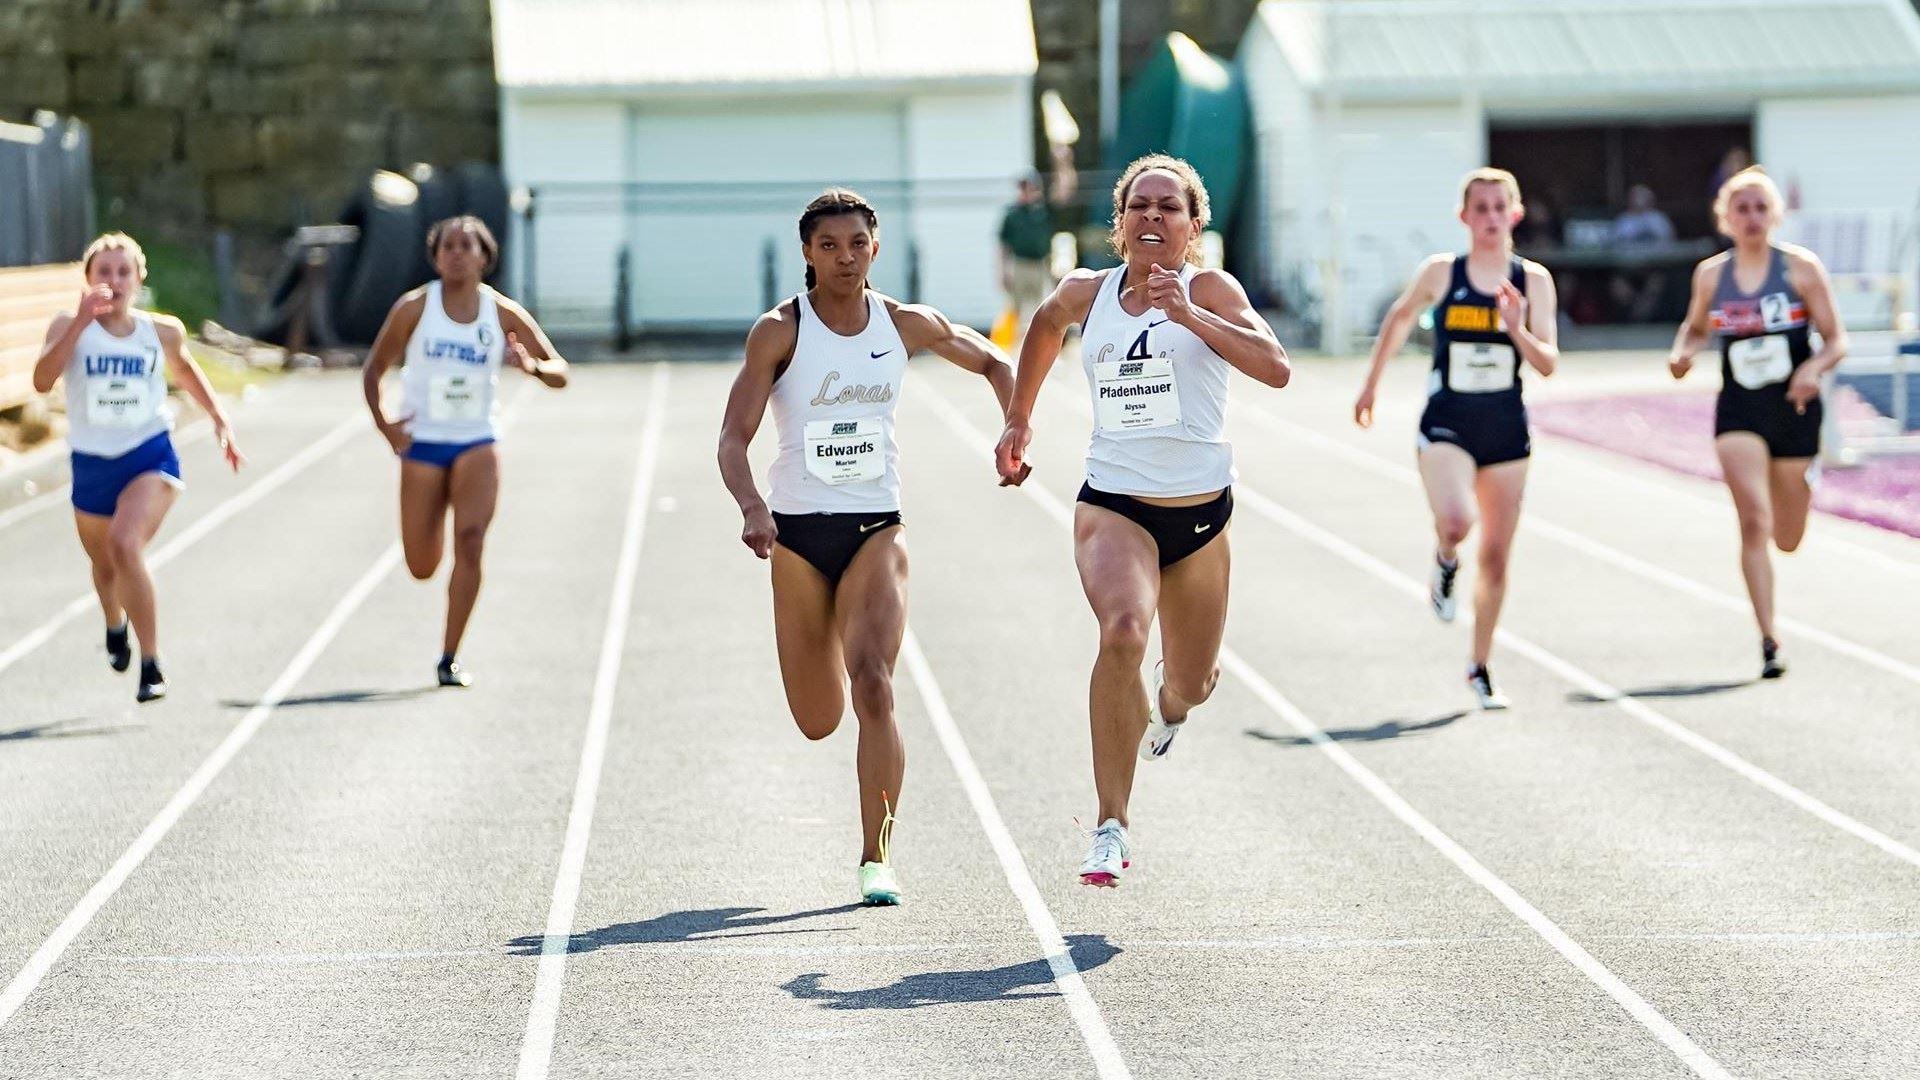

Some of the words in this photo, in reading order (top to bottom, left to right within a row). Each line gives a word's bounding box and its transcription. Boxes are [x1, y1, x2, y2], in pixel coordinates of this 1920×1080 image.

[1766, 295, 1782, 324] 2
[1126, 329, 1153, 361] 4
[86, 355, 144, 376] LUTHE
[810, 371, 893, 406] Loras
[1100, 383, 1172, 399] Pfadenhauer
[1124, 403, 1147, 411] Alyssa
[816, 441, 874, 457] Edwards
